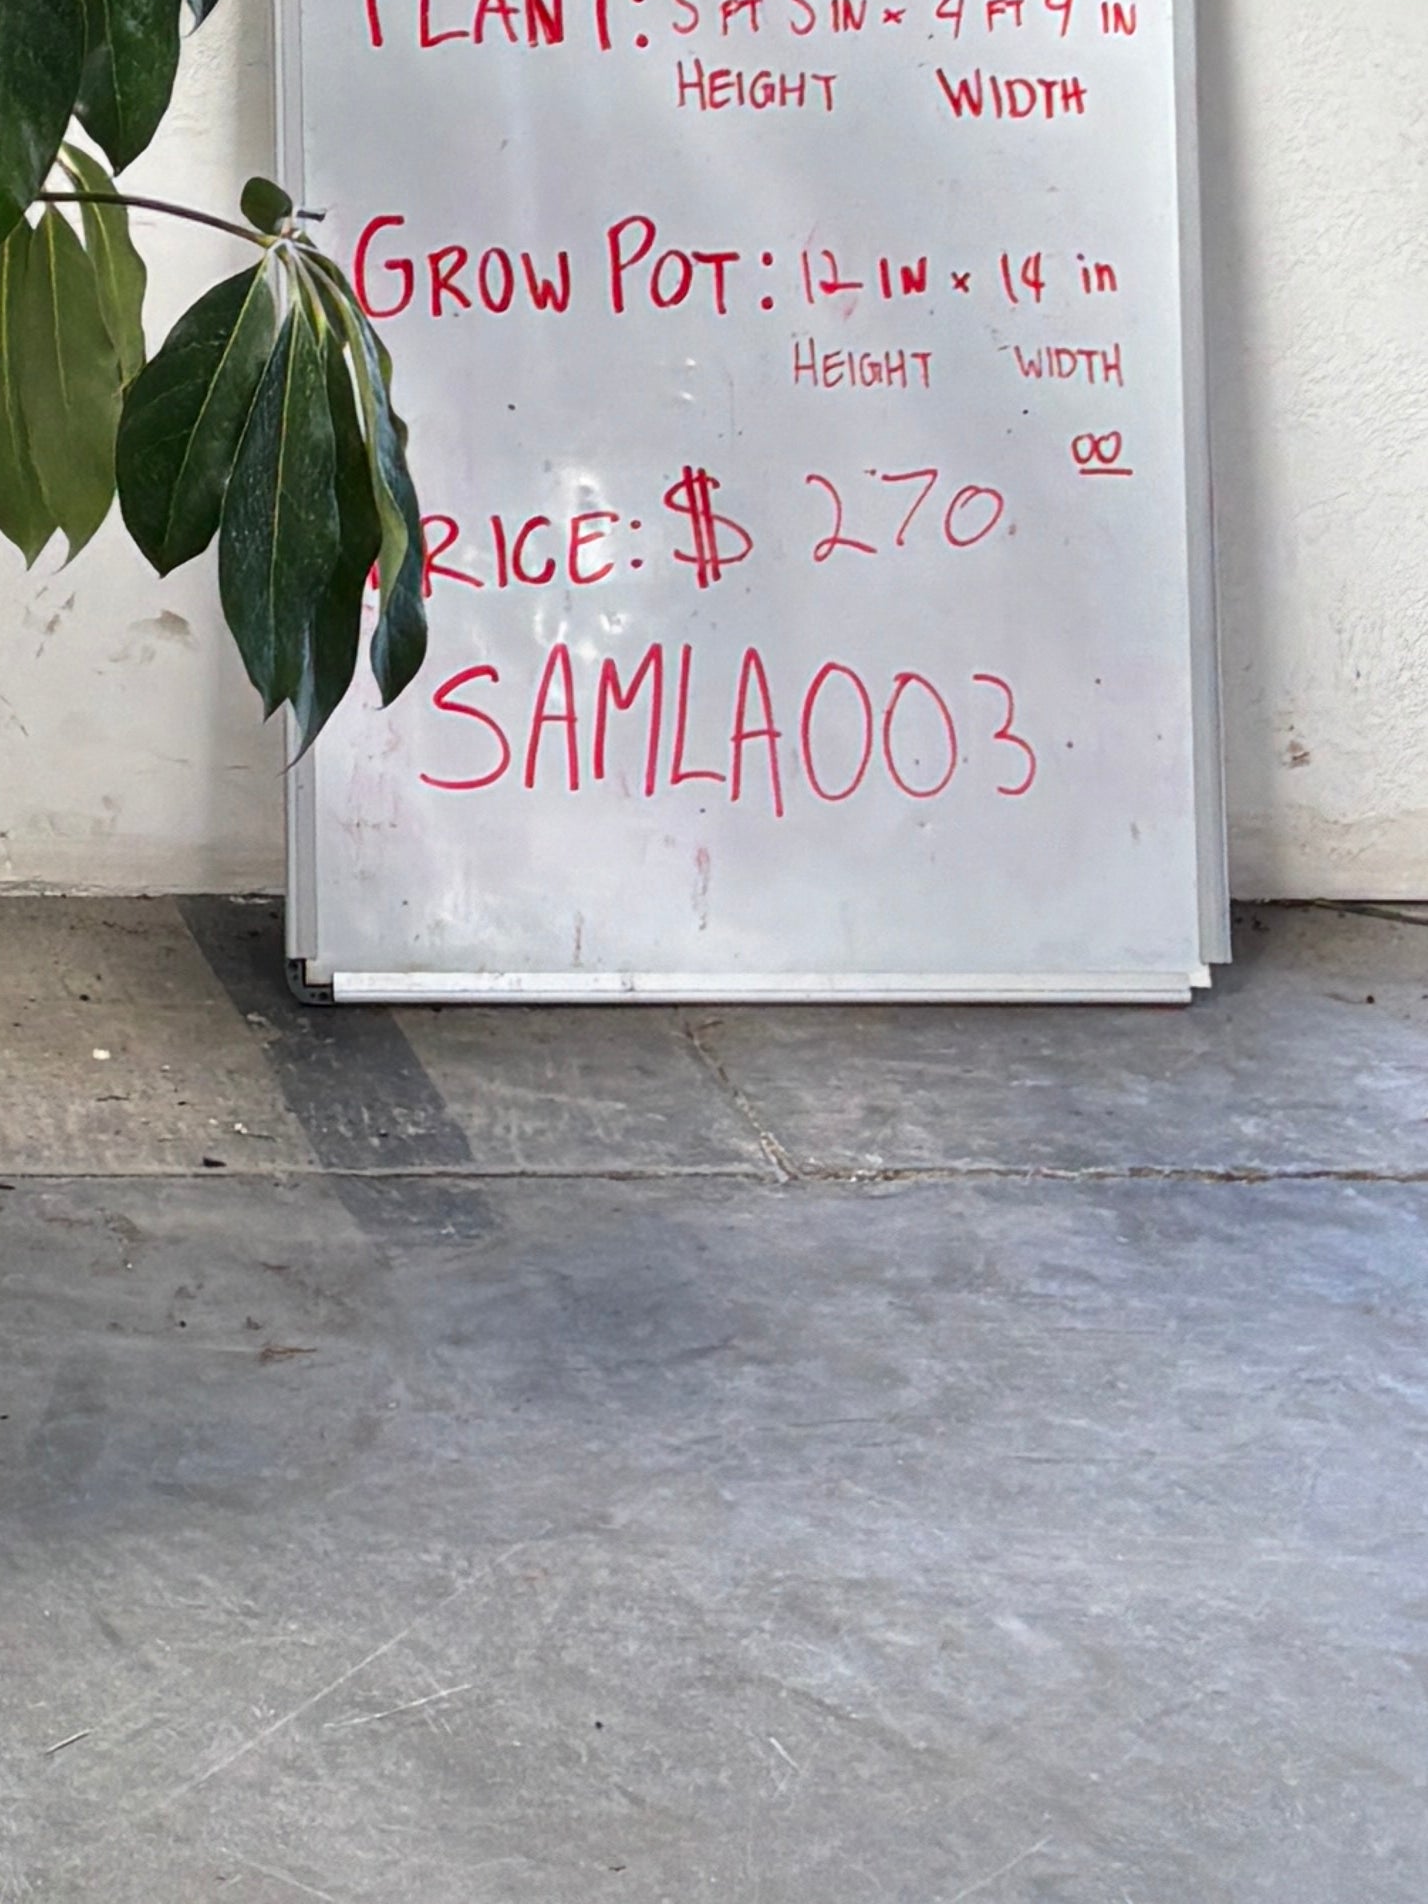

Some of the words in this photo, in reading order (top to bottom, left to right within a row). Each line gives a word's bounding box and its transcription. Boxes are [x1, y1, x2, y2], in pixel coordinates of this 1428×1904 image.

[1100, 1, 1138, 37] IN
[676, 58, 837, 112] HEIGHT
[936, 68, 1087, 120] WIDTH
[354, 214, 571, 318] GROW
[607, 216, 774, 314] POT:
[800, 249, 863, 304] 12
[878, 256, 928, 300] IN
[999, 251, 1045, 304] 14
[793, 337, 932, 389] HEIGHT
[1014, 342, 1124, 387] WIDTH
[368, 512, 641, 599] RICE:
[663, 465, 753, 590] $
[805, 468, 1004, 563] 270
[419, 643, 1036, 818] SAMLA003
